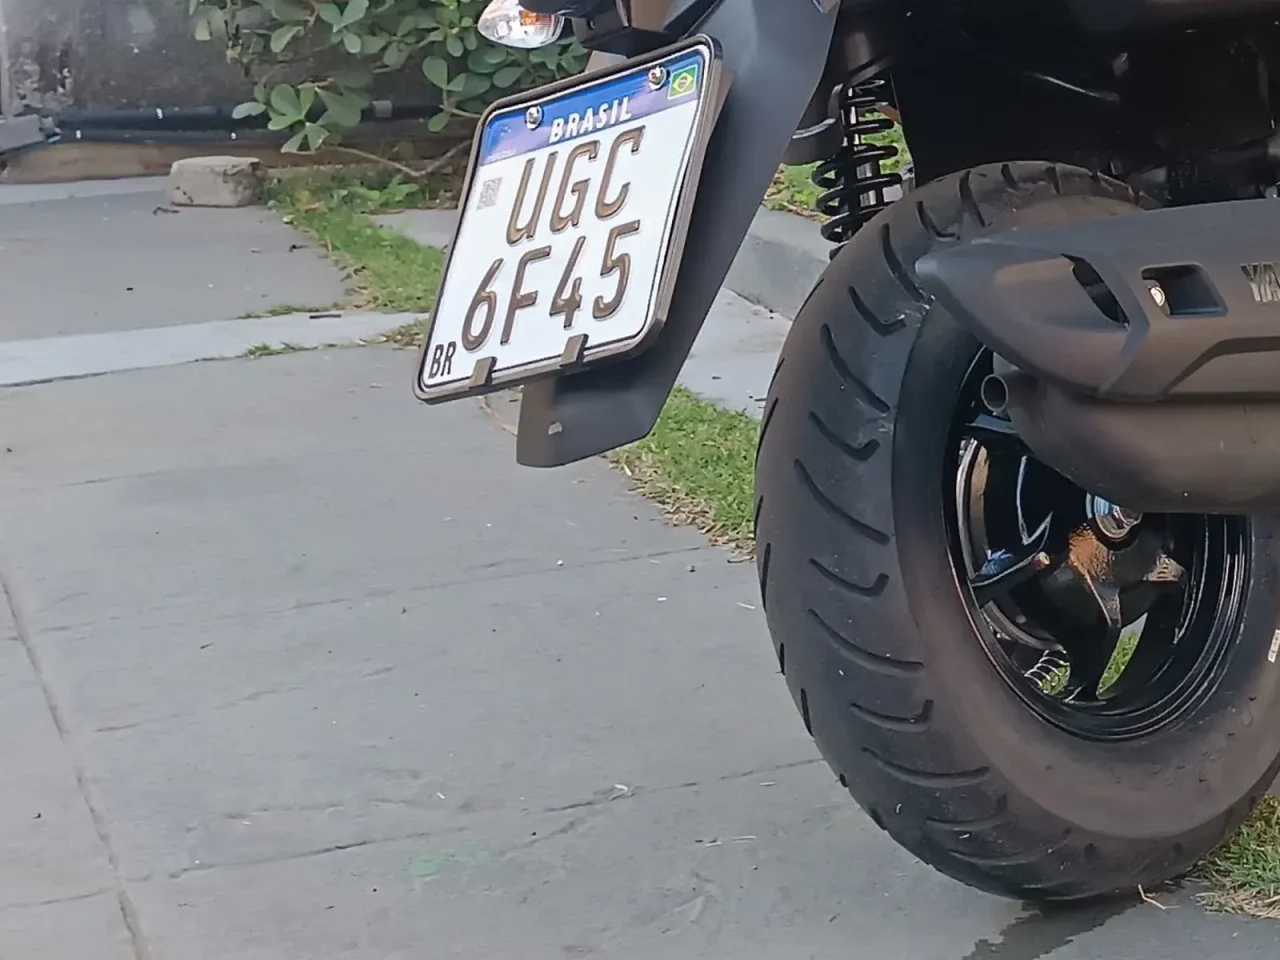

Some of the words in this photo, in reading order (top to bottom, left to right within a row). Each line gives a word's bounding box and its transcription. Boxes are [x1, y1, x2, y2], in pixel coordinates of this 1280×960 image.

[550, 96, 632, 142] BRASIL
[506, 125, 646, 245] UGC
[461, 219, 641, 351] 6F45
[428, 342, 456, 379] BR
